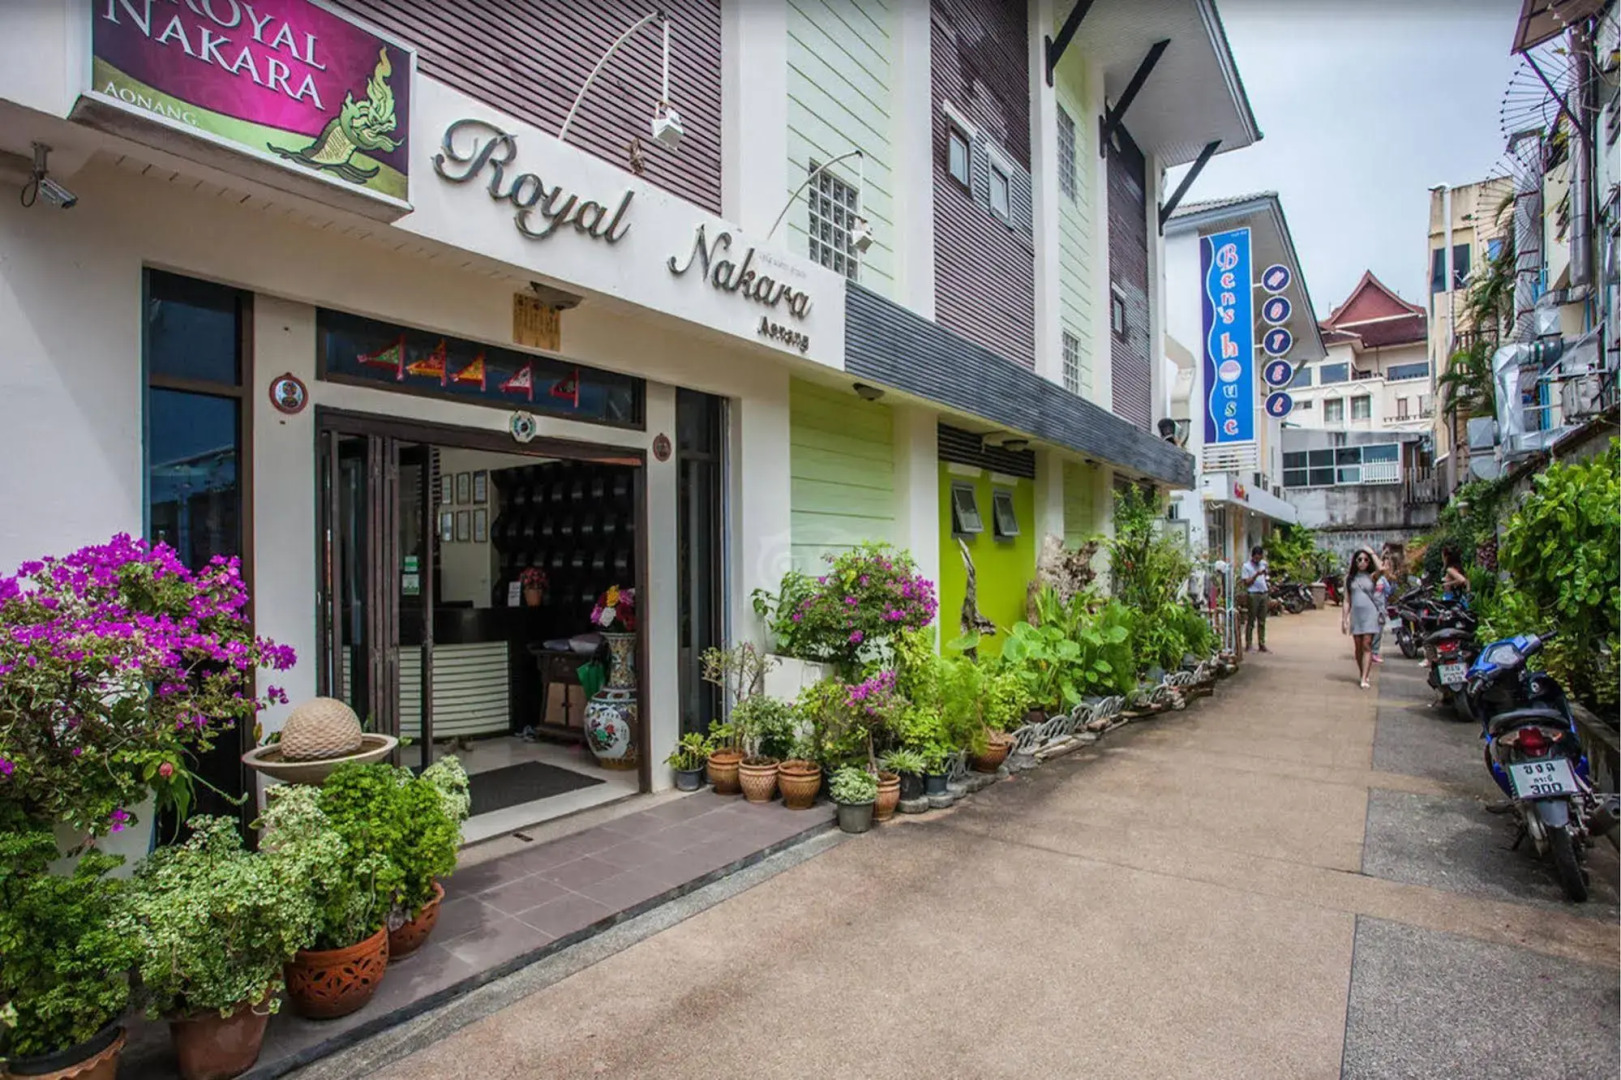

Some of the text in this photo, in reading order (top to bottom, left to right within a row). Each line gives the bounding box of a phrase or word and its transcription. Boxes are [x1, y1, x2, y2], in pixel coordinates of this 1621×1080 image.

[102, 0, 327, 111] NAKARA
[168, 0, 327, 71] OYAL
[103, 81, 198, 126] AONANG
[431, 118, 814, 321] Royal Nakara
[1216, 243, 1239, 325] Ben's
[1266, 269, 1286, 414] HOTEL
[1530, 782, 1564, 795] 300
